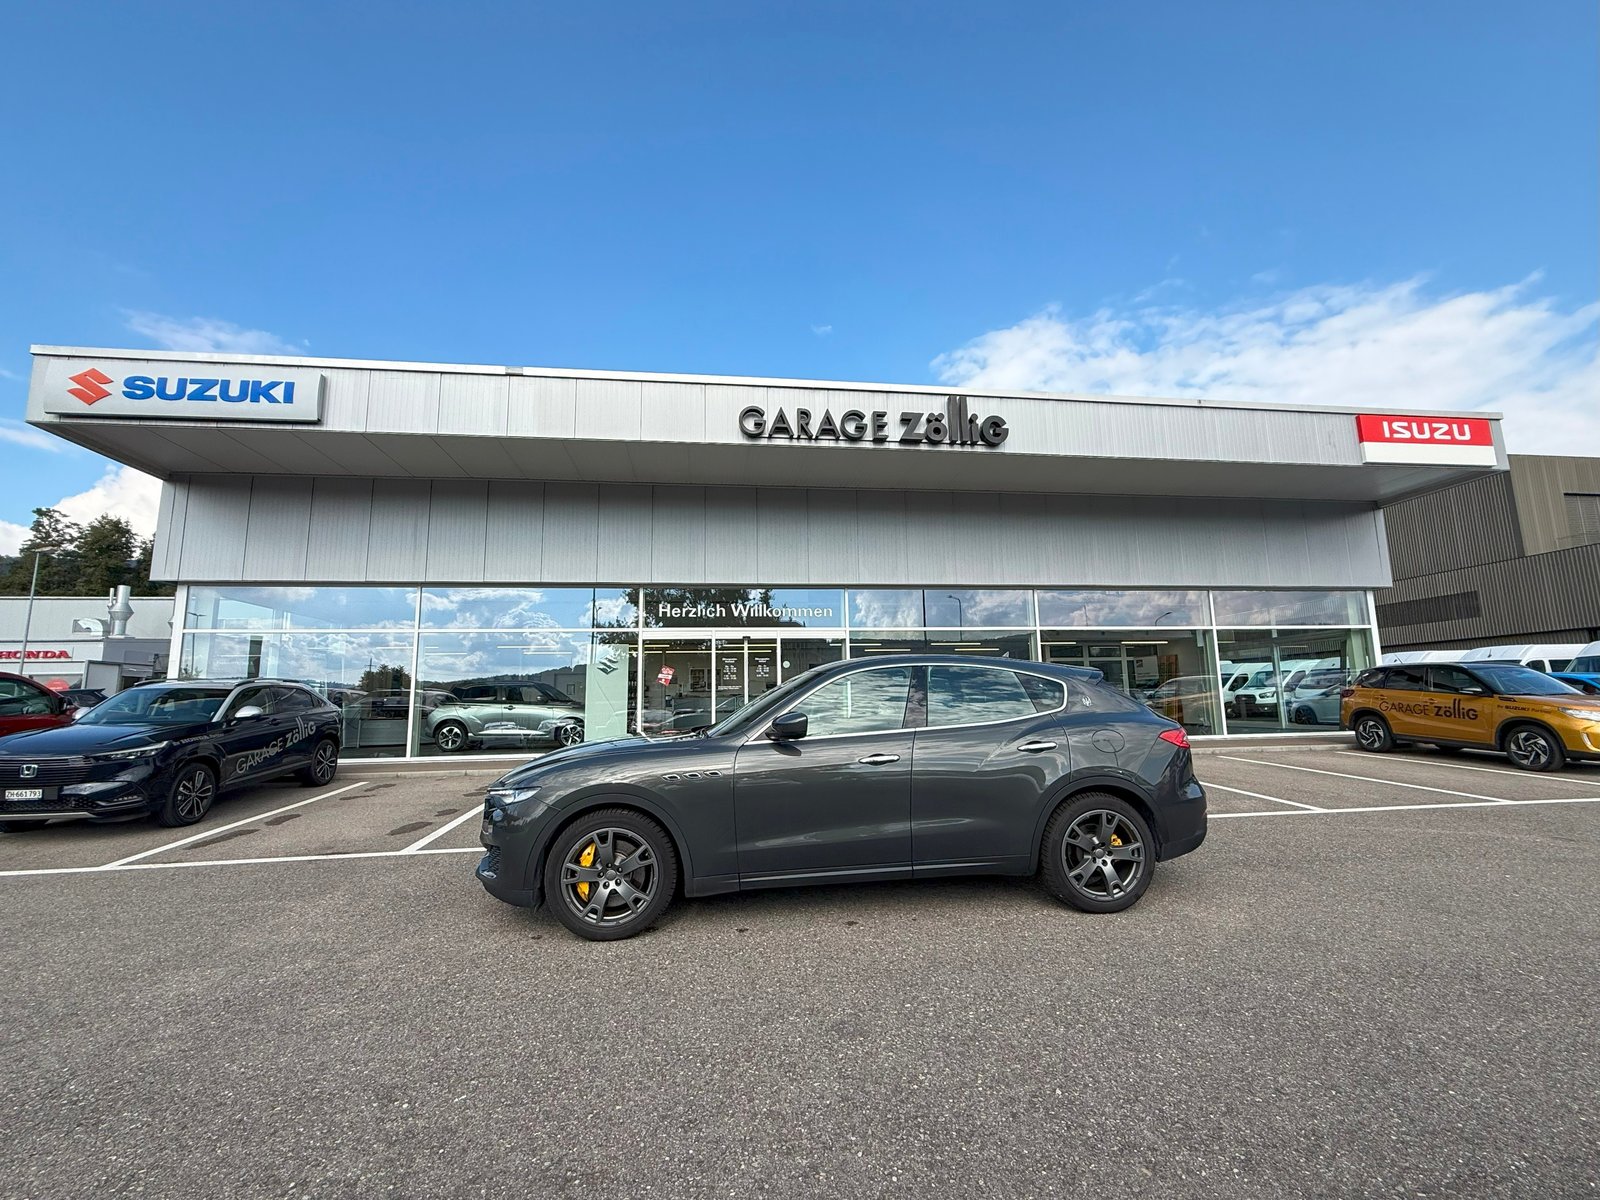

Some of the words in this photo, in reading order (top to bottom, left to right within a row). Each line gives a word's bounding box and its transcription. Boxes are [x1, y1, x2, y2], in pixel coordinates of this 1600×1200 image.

[122, 376, 295, 404] SUZUKI
[738, 405, 888, 442] GARAGE
[1382, 421, 1471, 440] ISUZU
[658, 603, 726, 618] Herzlich
[731, 603, 833, 618] Willkommen
[0, 650, 73, 659] HONDA
[1379, 701, 1430, 716] GARAGE
[236, 737, 284, 774] GARAGE
